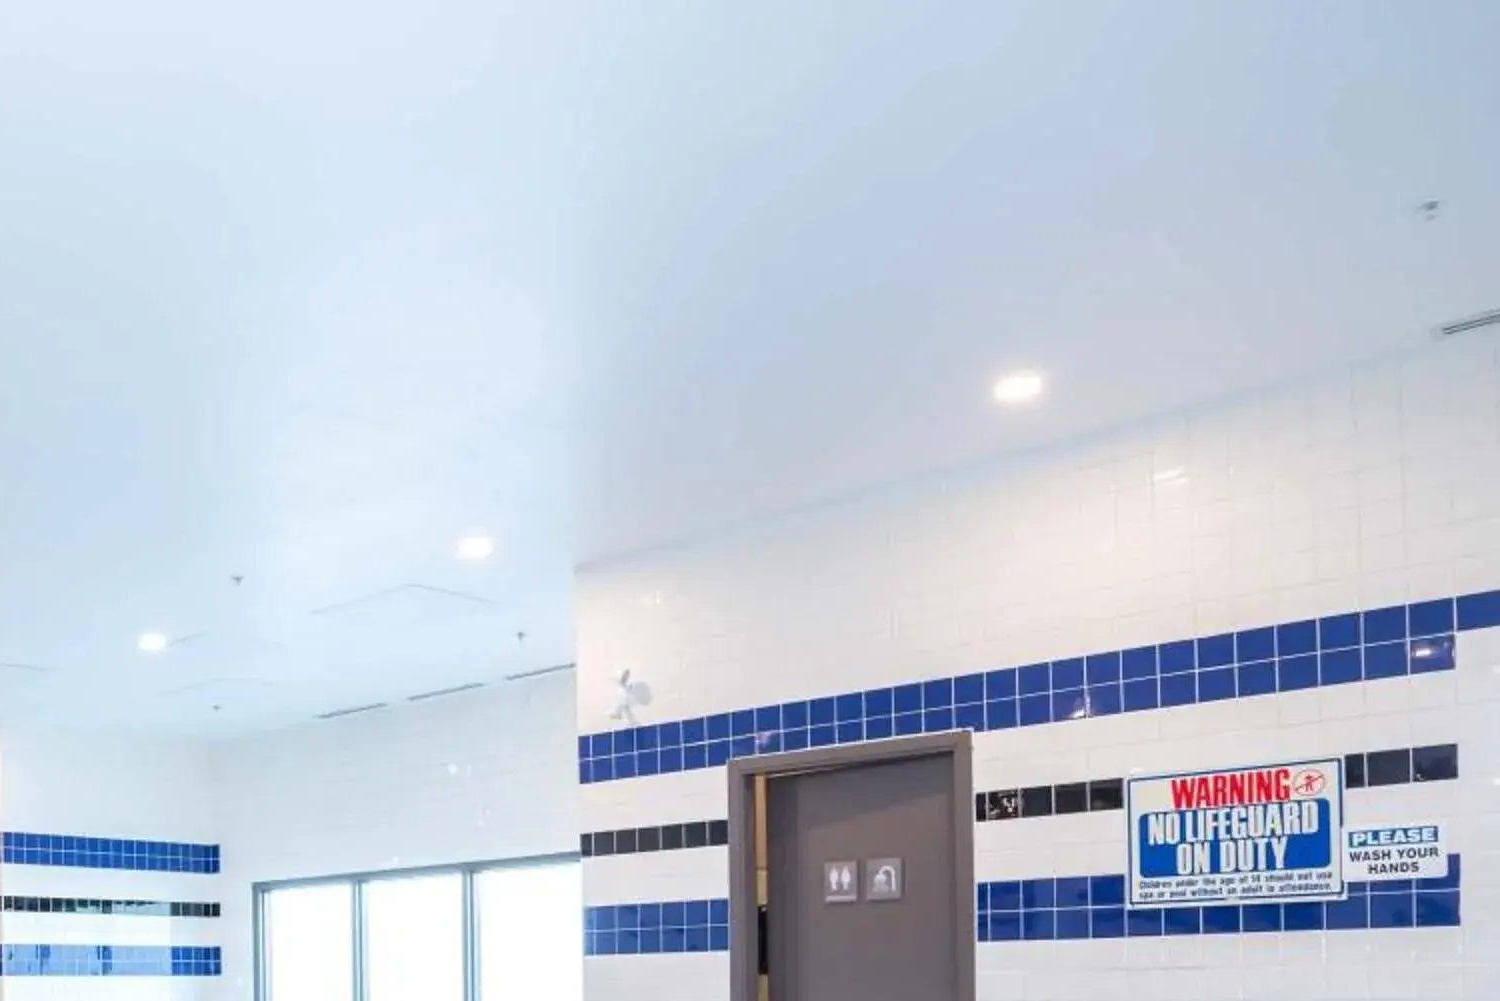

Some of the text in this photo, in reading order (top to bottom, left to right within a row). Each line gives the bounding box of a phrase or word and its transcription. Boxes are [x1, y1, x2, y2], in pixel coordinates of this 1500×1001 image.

[1171, 767, 1291, 811] WARNING
[1148, 801, 1319, 846] NO LIFEGUARD
[1352, 827, 1435, 847] PLEASE
[1176, 836, 1288, 875] ON DUTY
[1349, 846, 1439, 862] WASH YOUR
[1368, 862, 1420, 874] HANDS
